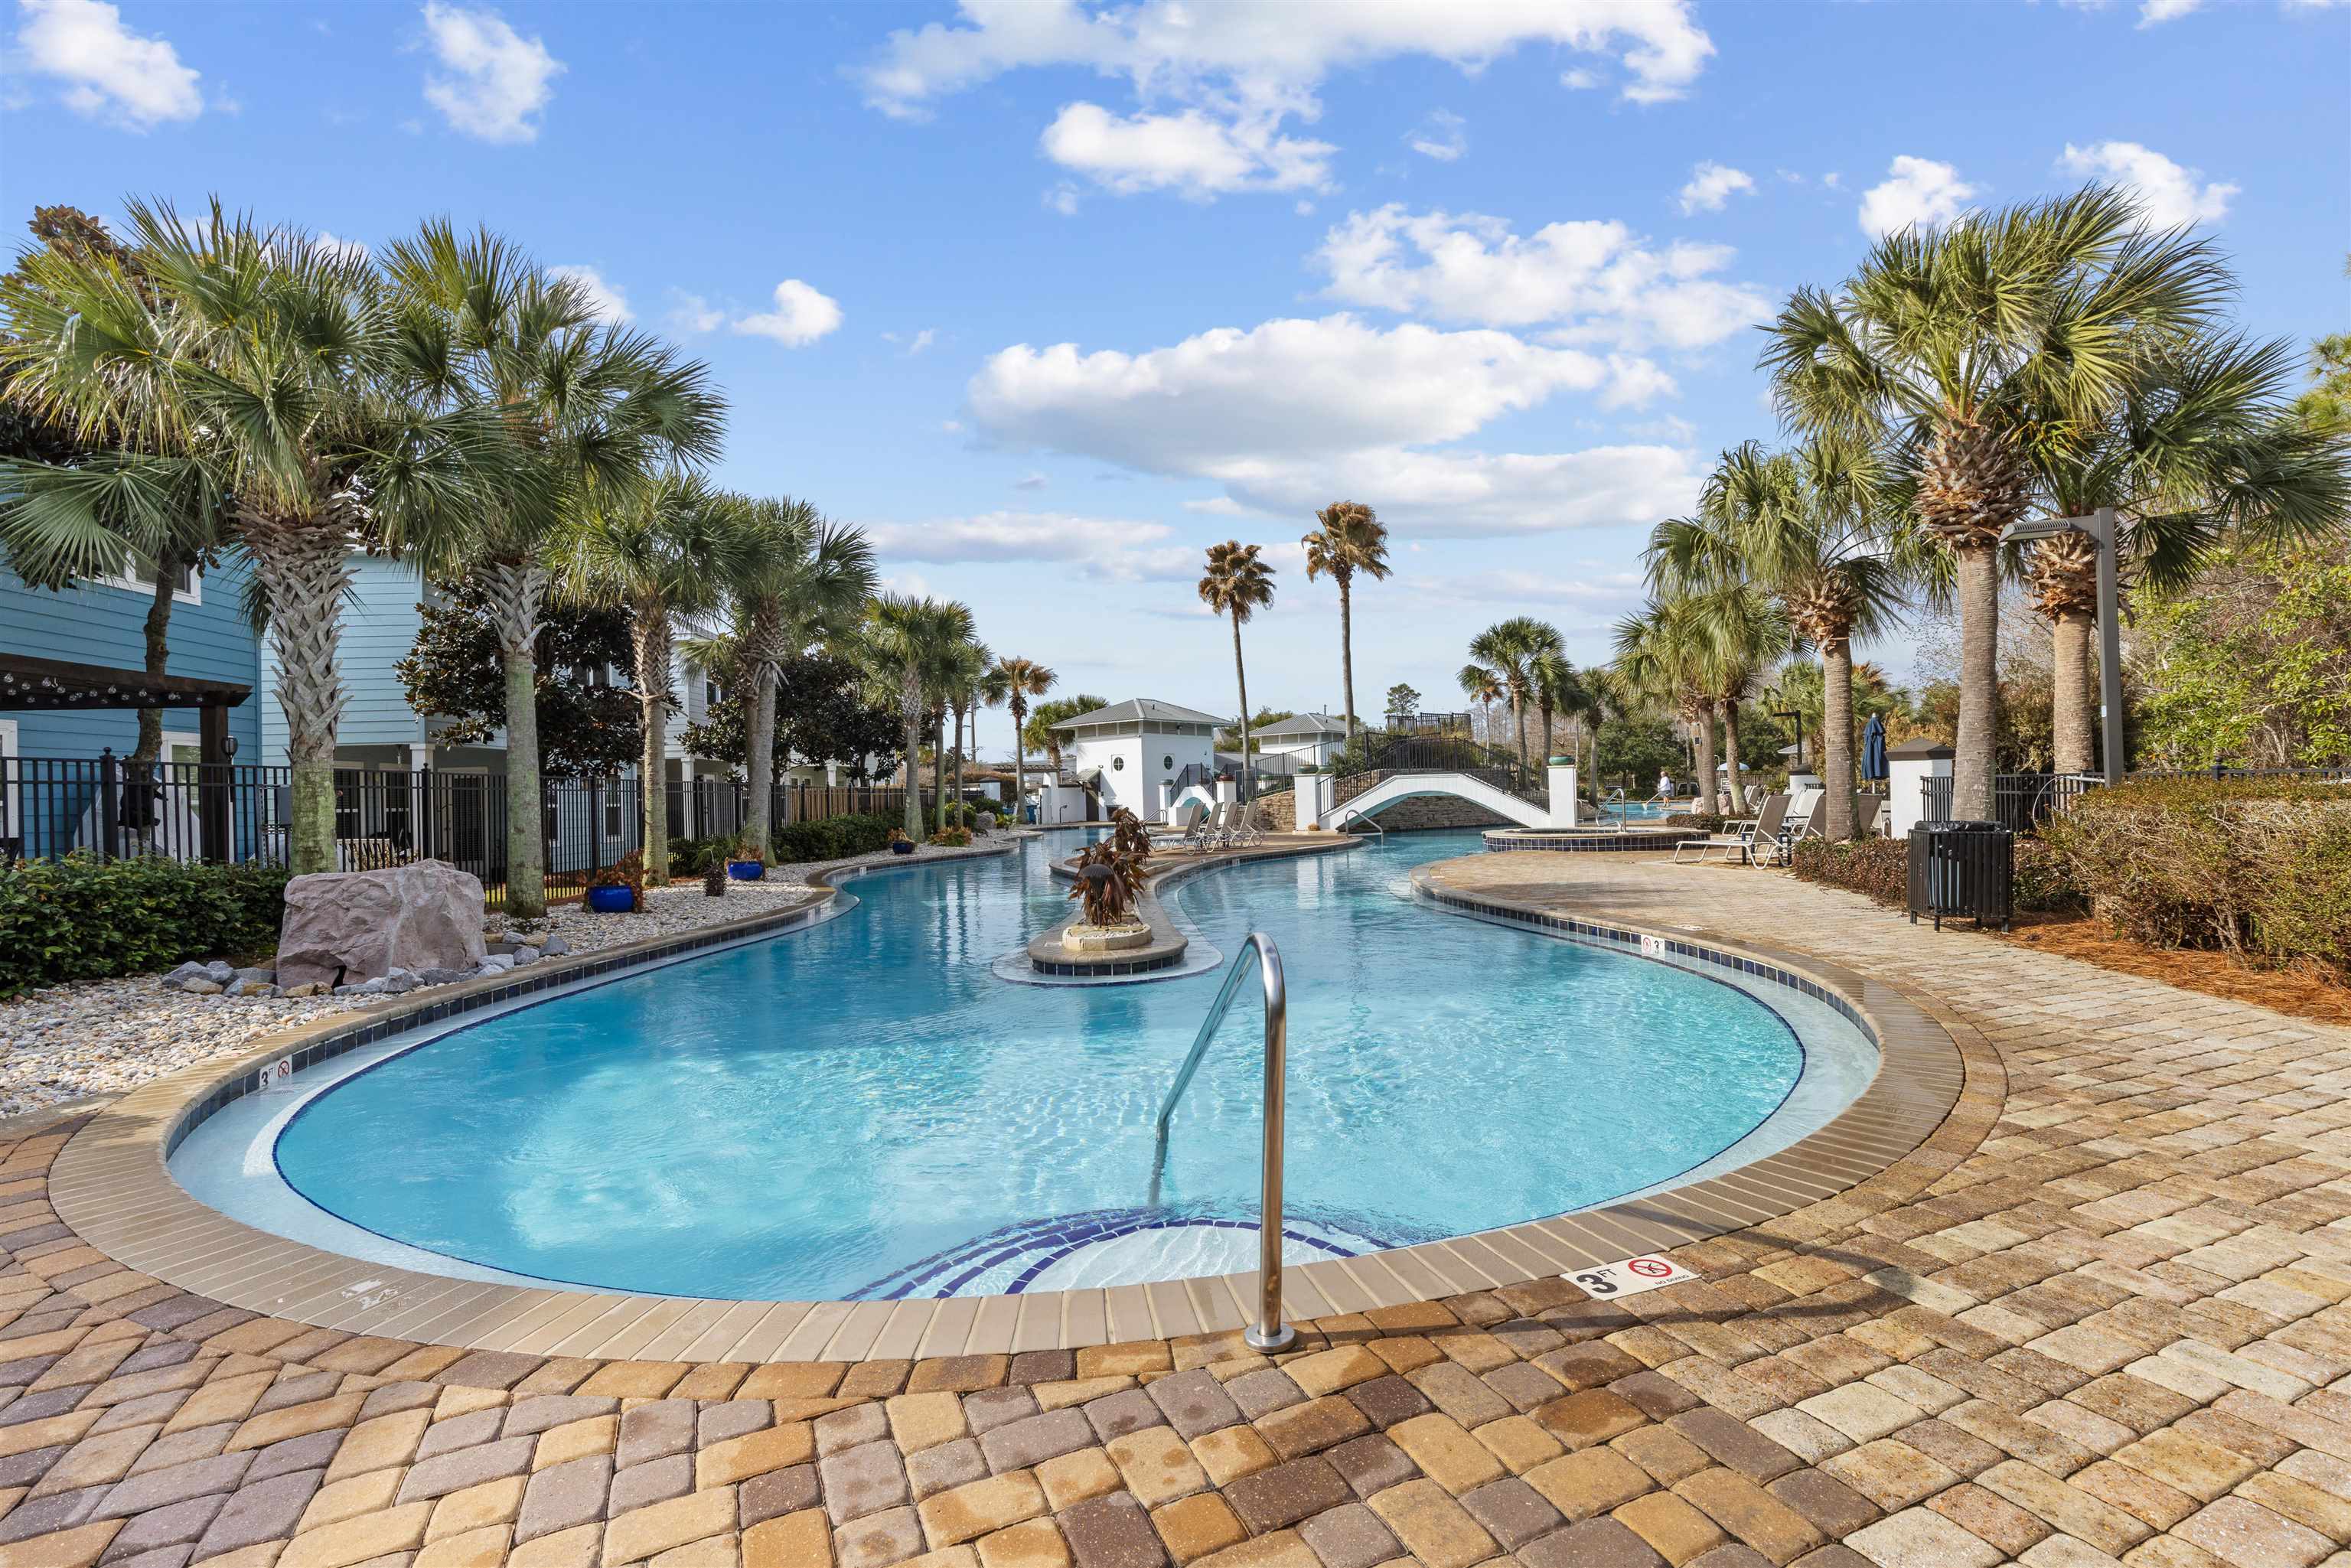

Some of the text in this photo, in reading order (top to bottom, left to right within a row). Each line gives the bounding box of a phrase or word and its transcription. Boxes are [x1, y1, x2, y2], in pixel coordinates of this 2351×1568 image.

[261, 1071, 269, 1087] 3
[1577, 1269, 1618, 1293] 3 FT
[1666, 1274, 1690, 1283] DIVING
